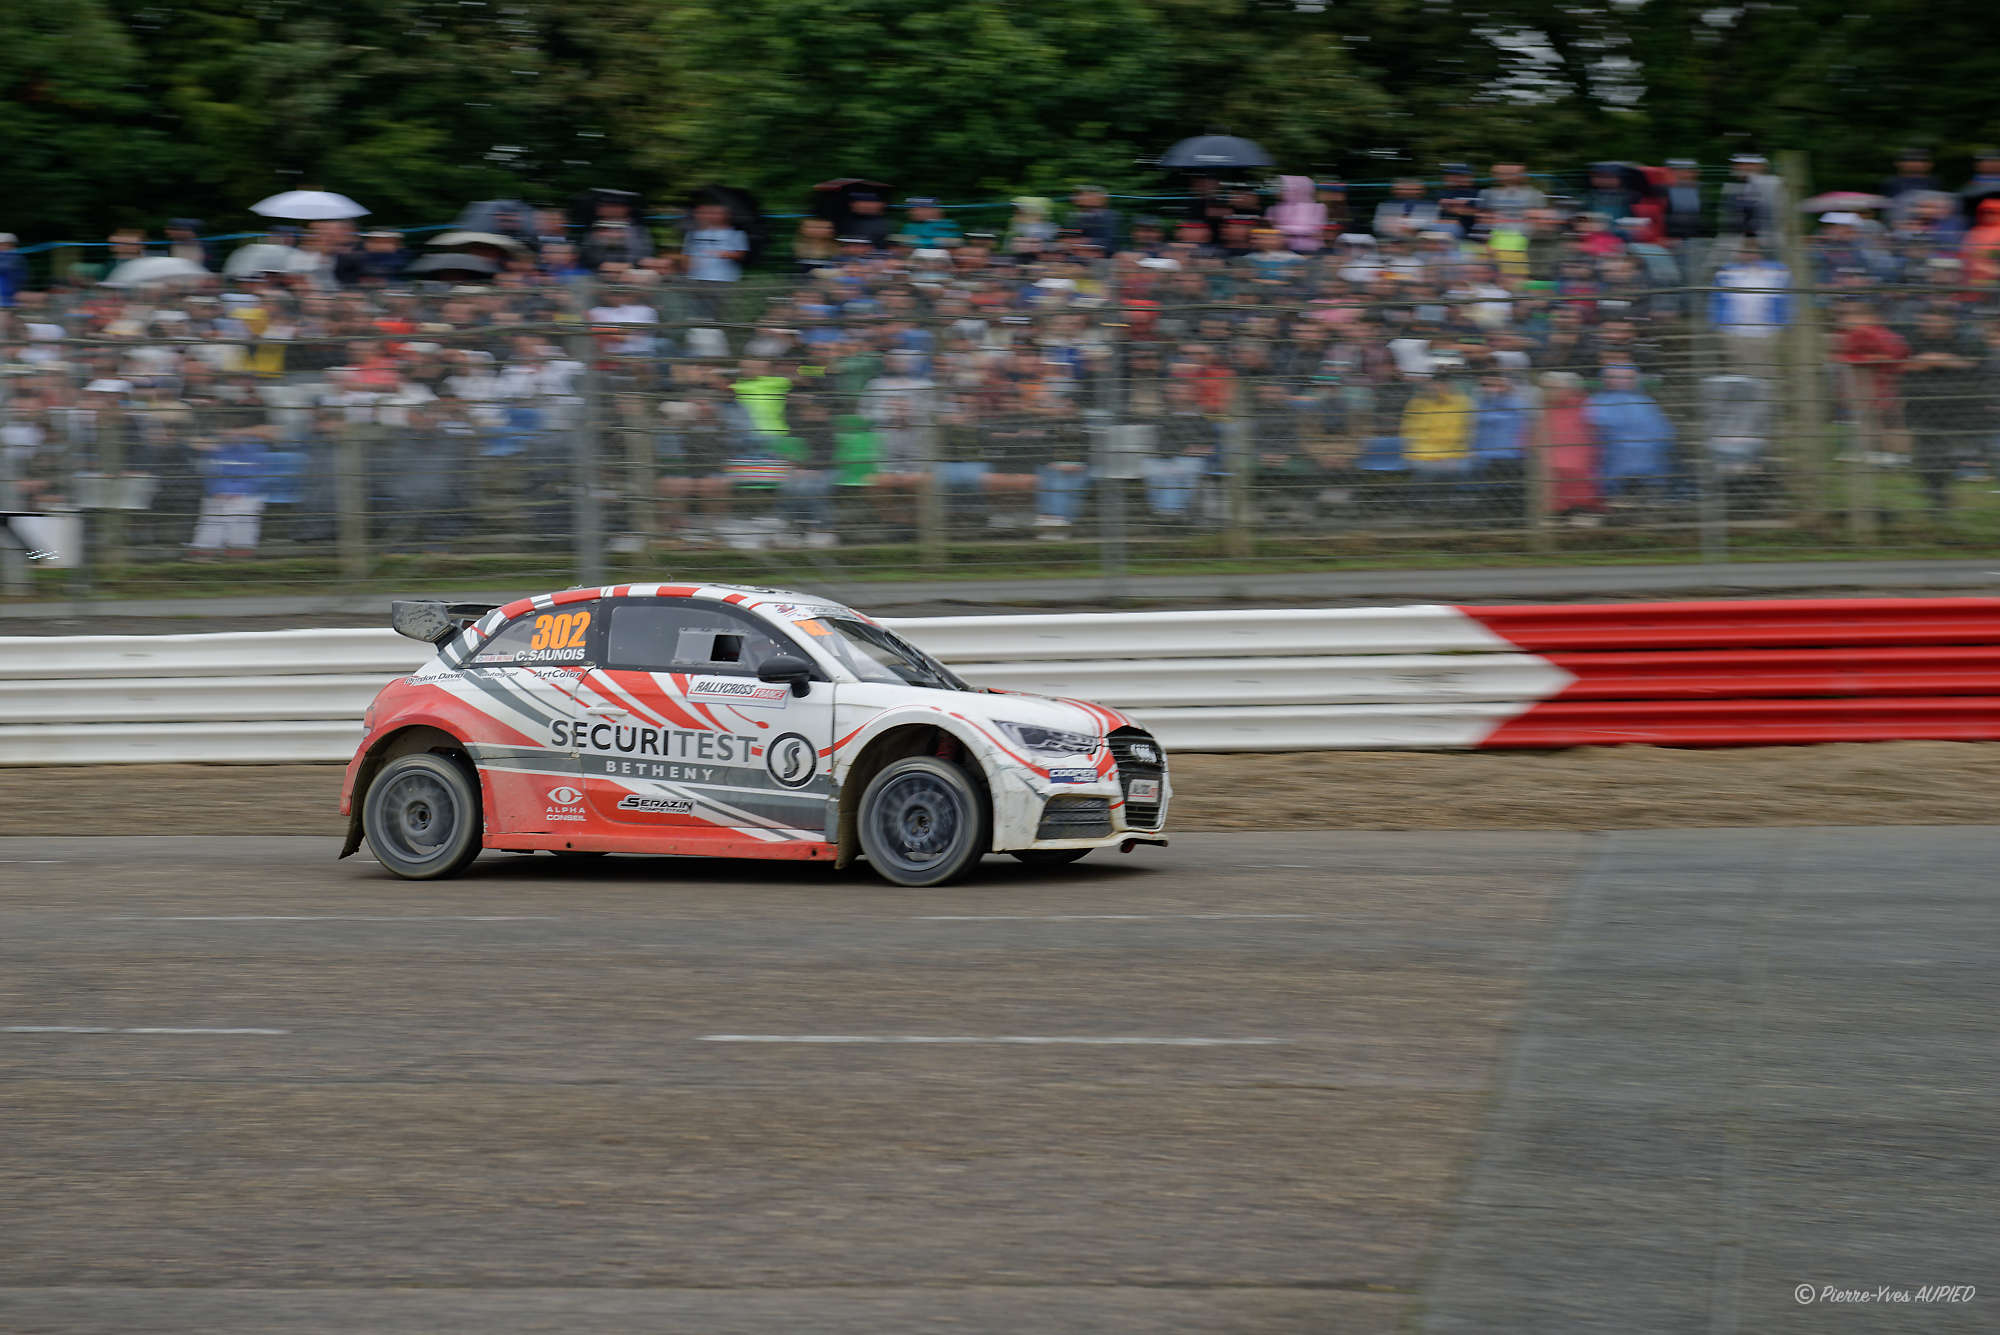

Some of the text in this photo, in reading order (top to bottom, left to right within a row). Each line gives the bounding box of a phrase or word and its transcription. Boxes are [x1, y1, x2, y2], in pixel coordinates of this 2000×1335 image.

[531, 611, 592, 651] 302
[516, 648, 585, 662] C.SAUNOIS
[694, 681, 757, 696] RALLYCROSS
[551, 719, 758, 763] SECURITEST
[605, 760, 714, 781] BETHENY
[546, 806, 586, 814] ALPHA
[620, 797, 694, 811] SERAZIN
